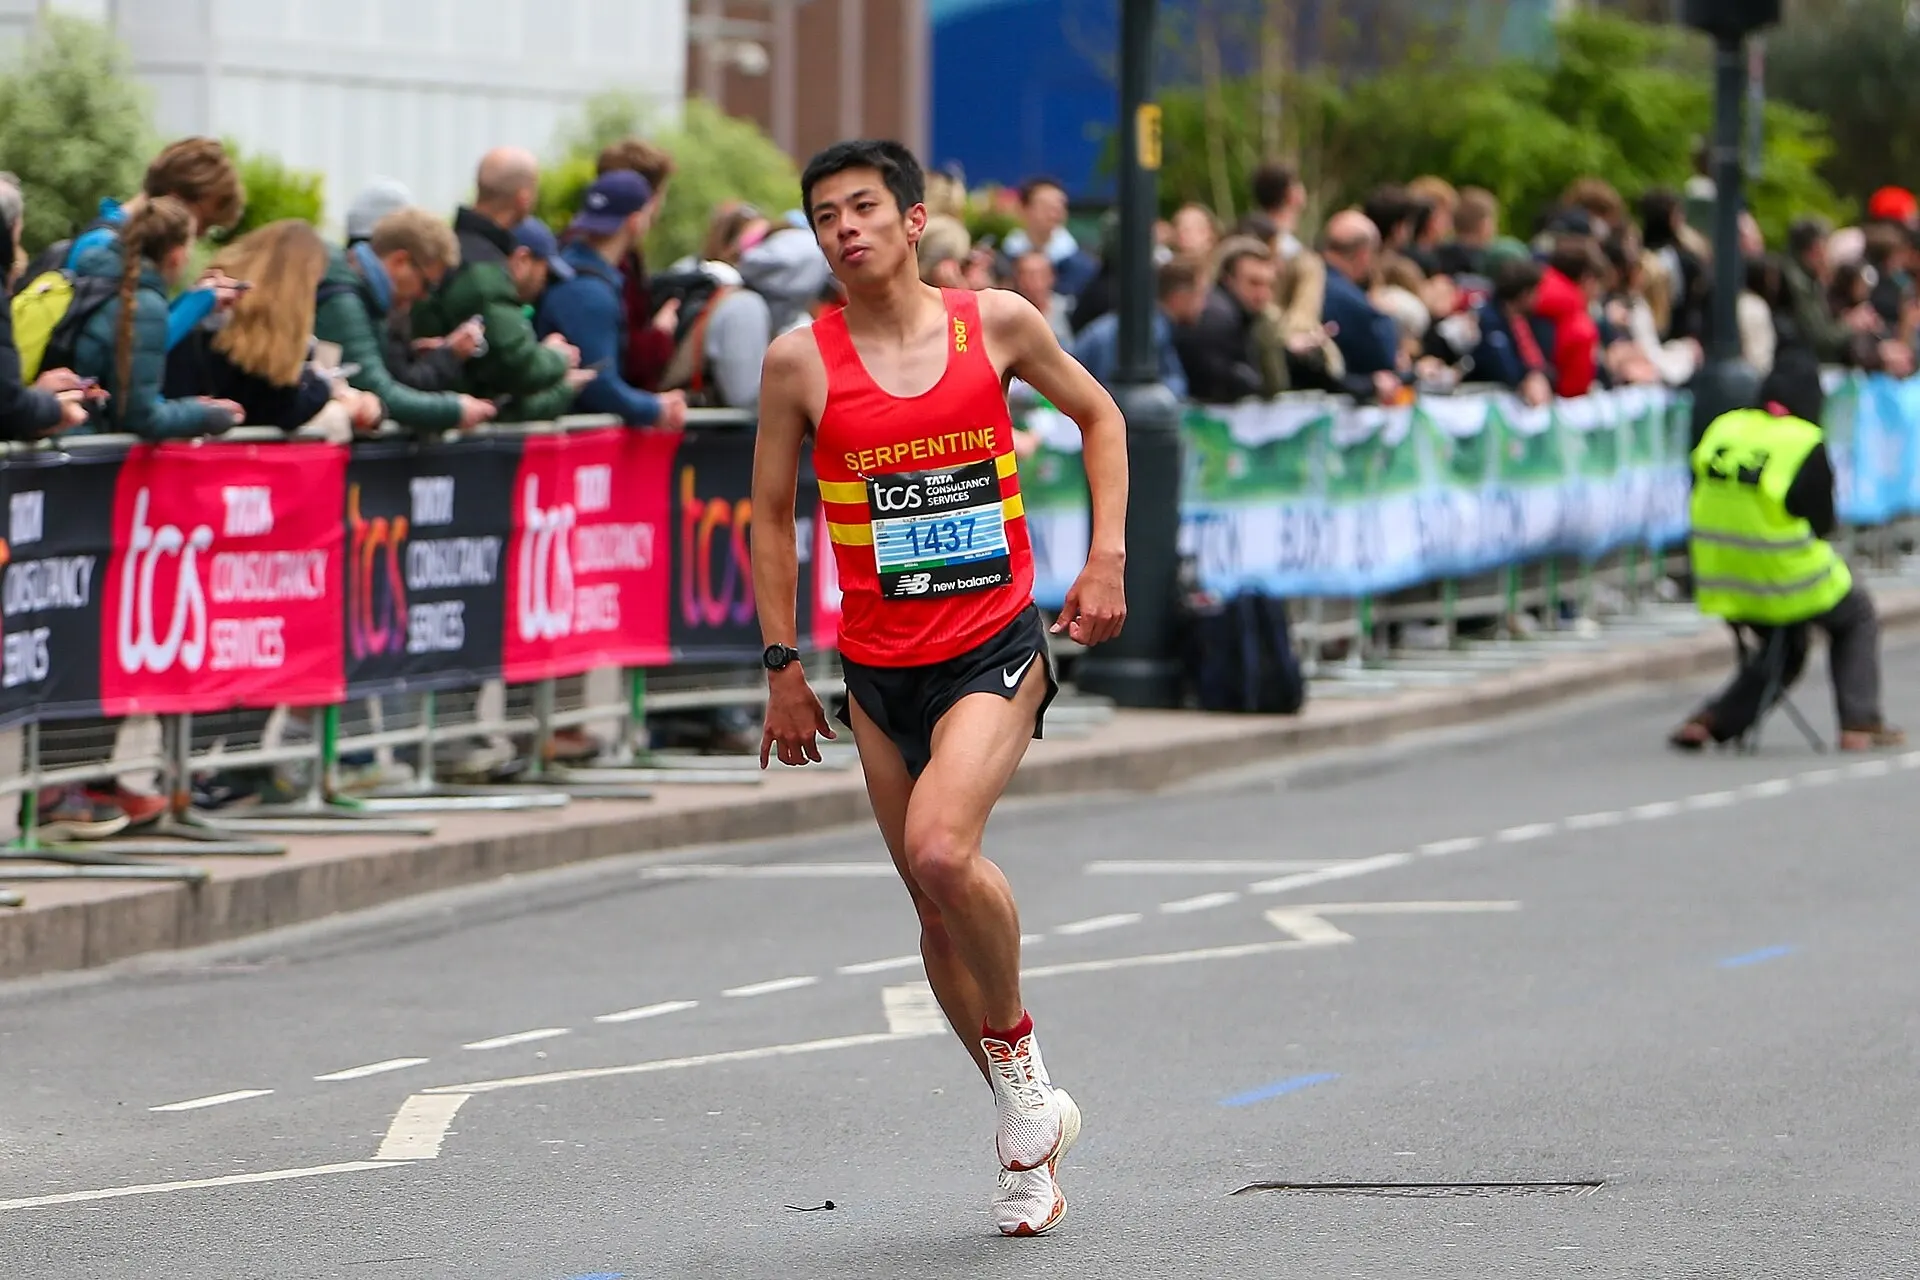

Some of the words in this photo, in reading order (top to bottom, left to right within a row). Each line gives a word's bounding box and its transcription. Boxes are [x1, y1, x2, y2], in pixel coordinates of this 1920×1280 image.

[953, 316, 968, 353] soar
[844, 426, 996, 471] SERPENTINE
[925, 474, 954, 486] TATA
[926, 476, 990, 496] CONSULTANCY
[873, 482, 922, 511] tcs
[928, 491, 970, 507] SERVICES
[905, 517, 976, 556] 1437
[118, 486, 214, 673] tcs
[932, 580, 956, 592] new
[957, 573, 1002, 590] balance
